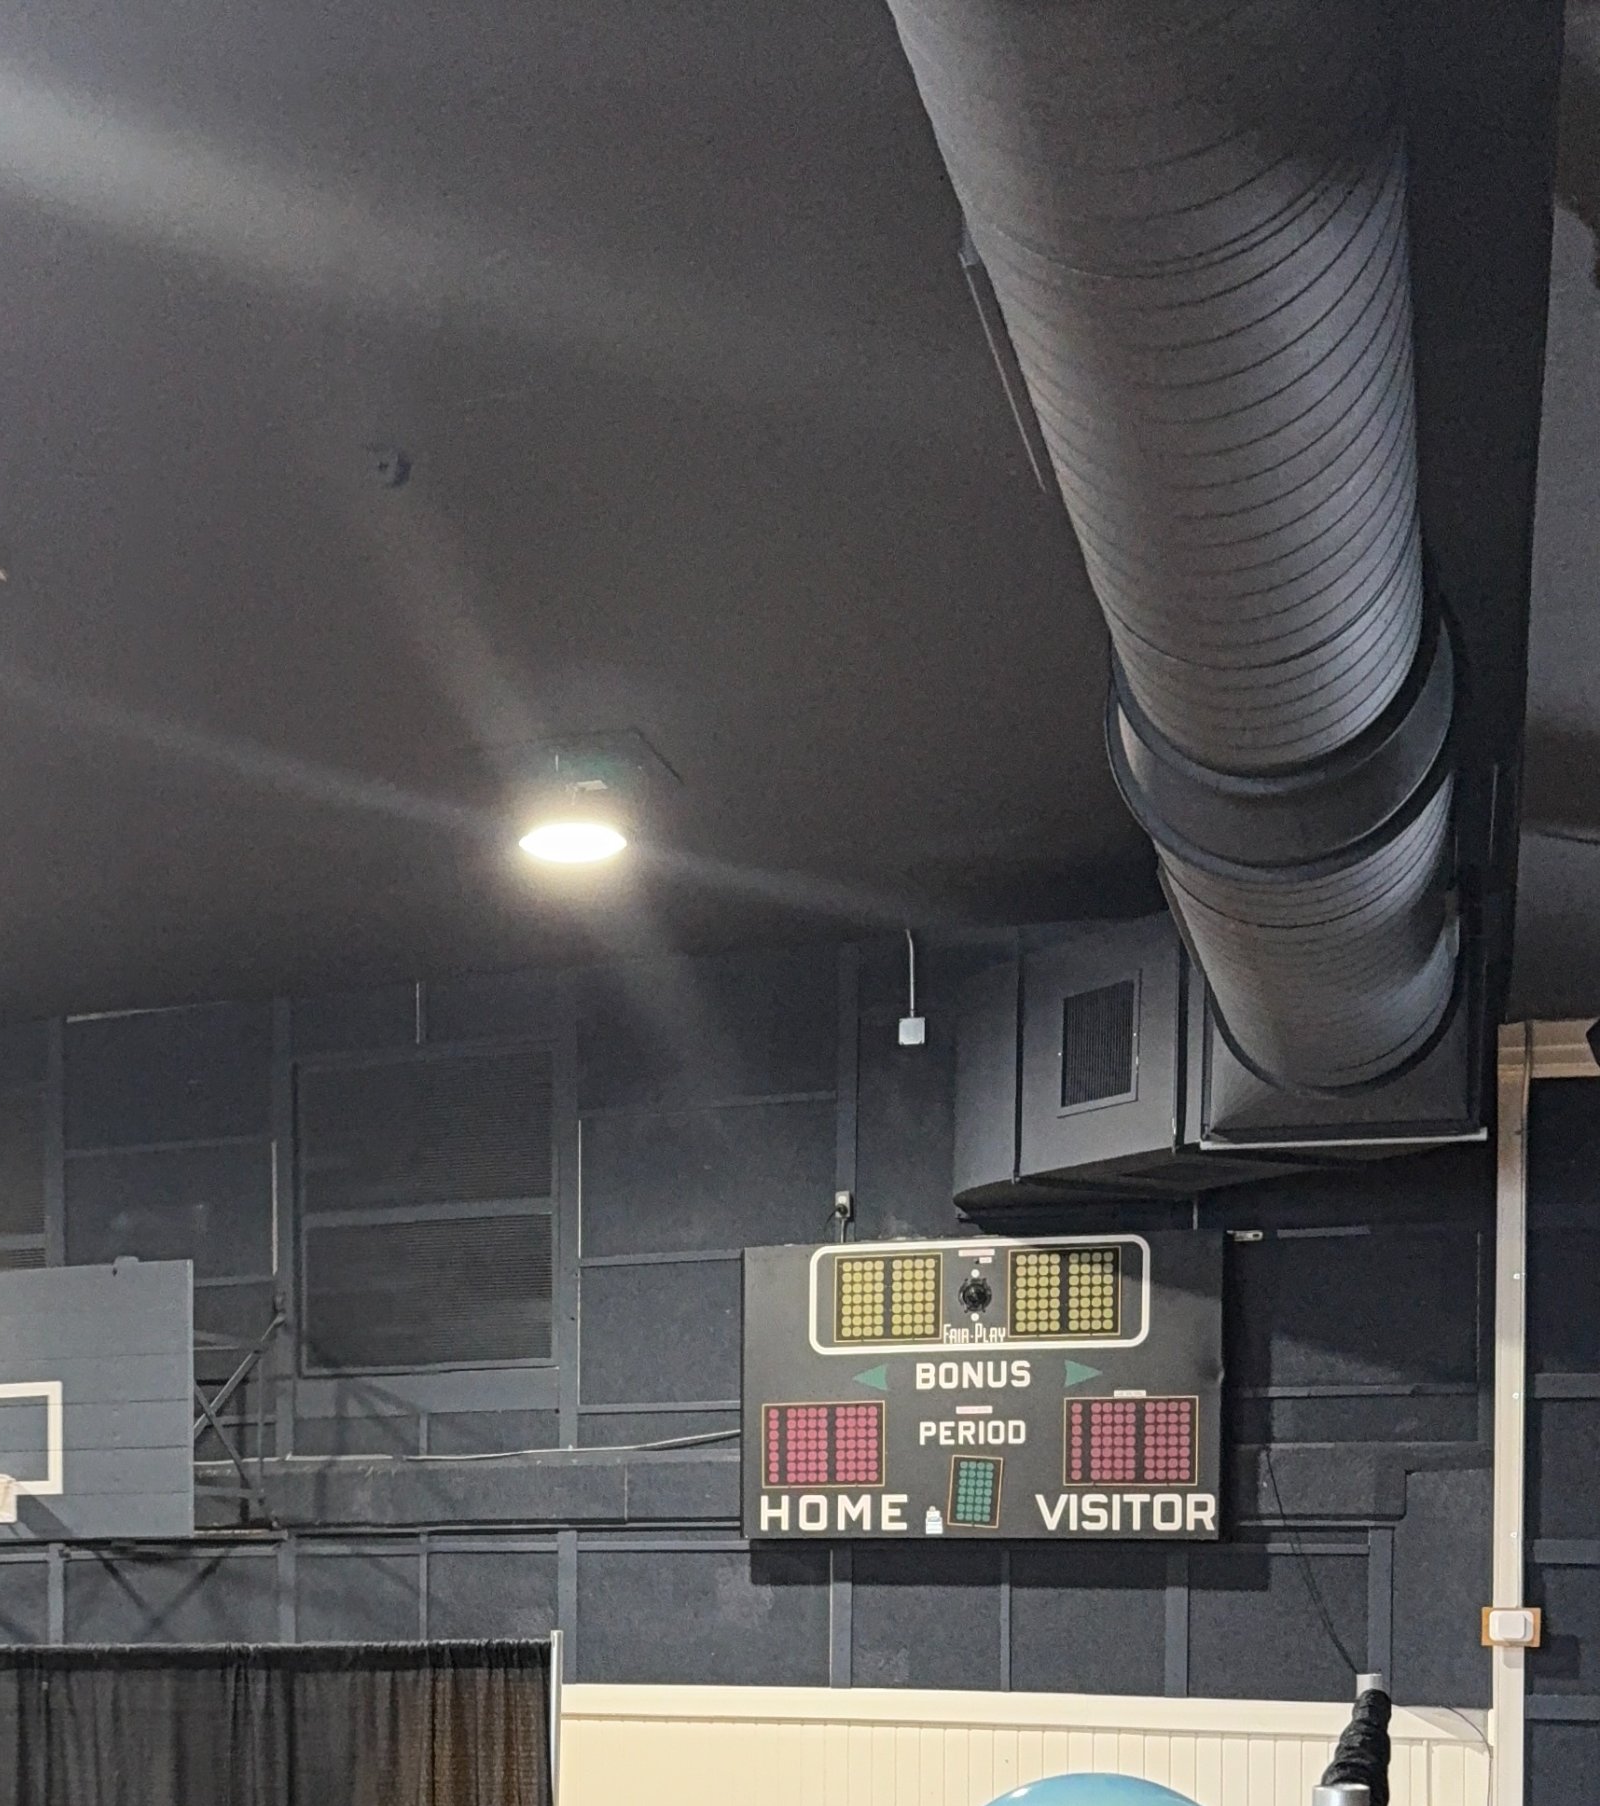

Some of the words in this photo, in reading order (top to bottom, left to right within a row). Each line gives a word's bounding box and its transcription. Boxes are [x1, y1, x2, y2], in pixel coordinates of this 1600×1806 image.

[915, 1360, 1031, 1390] BONUS
[919, 1419, 1026, 1446] PERIOD
[760, 1493, 908, 1531] HOME
[1034, 1493, 1216, 1531] VISITOR
